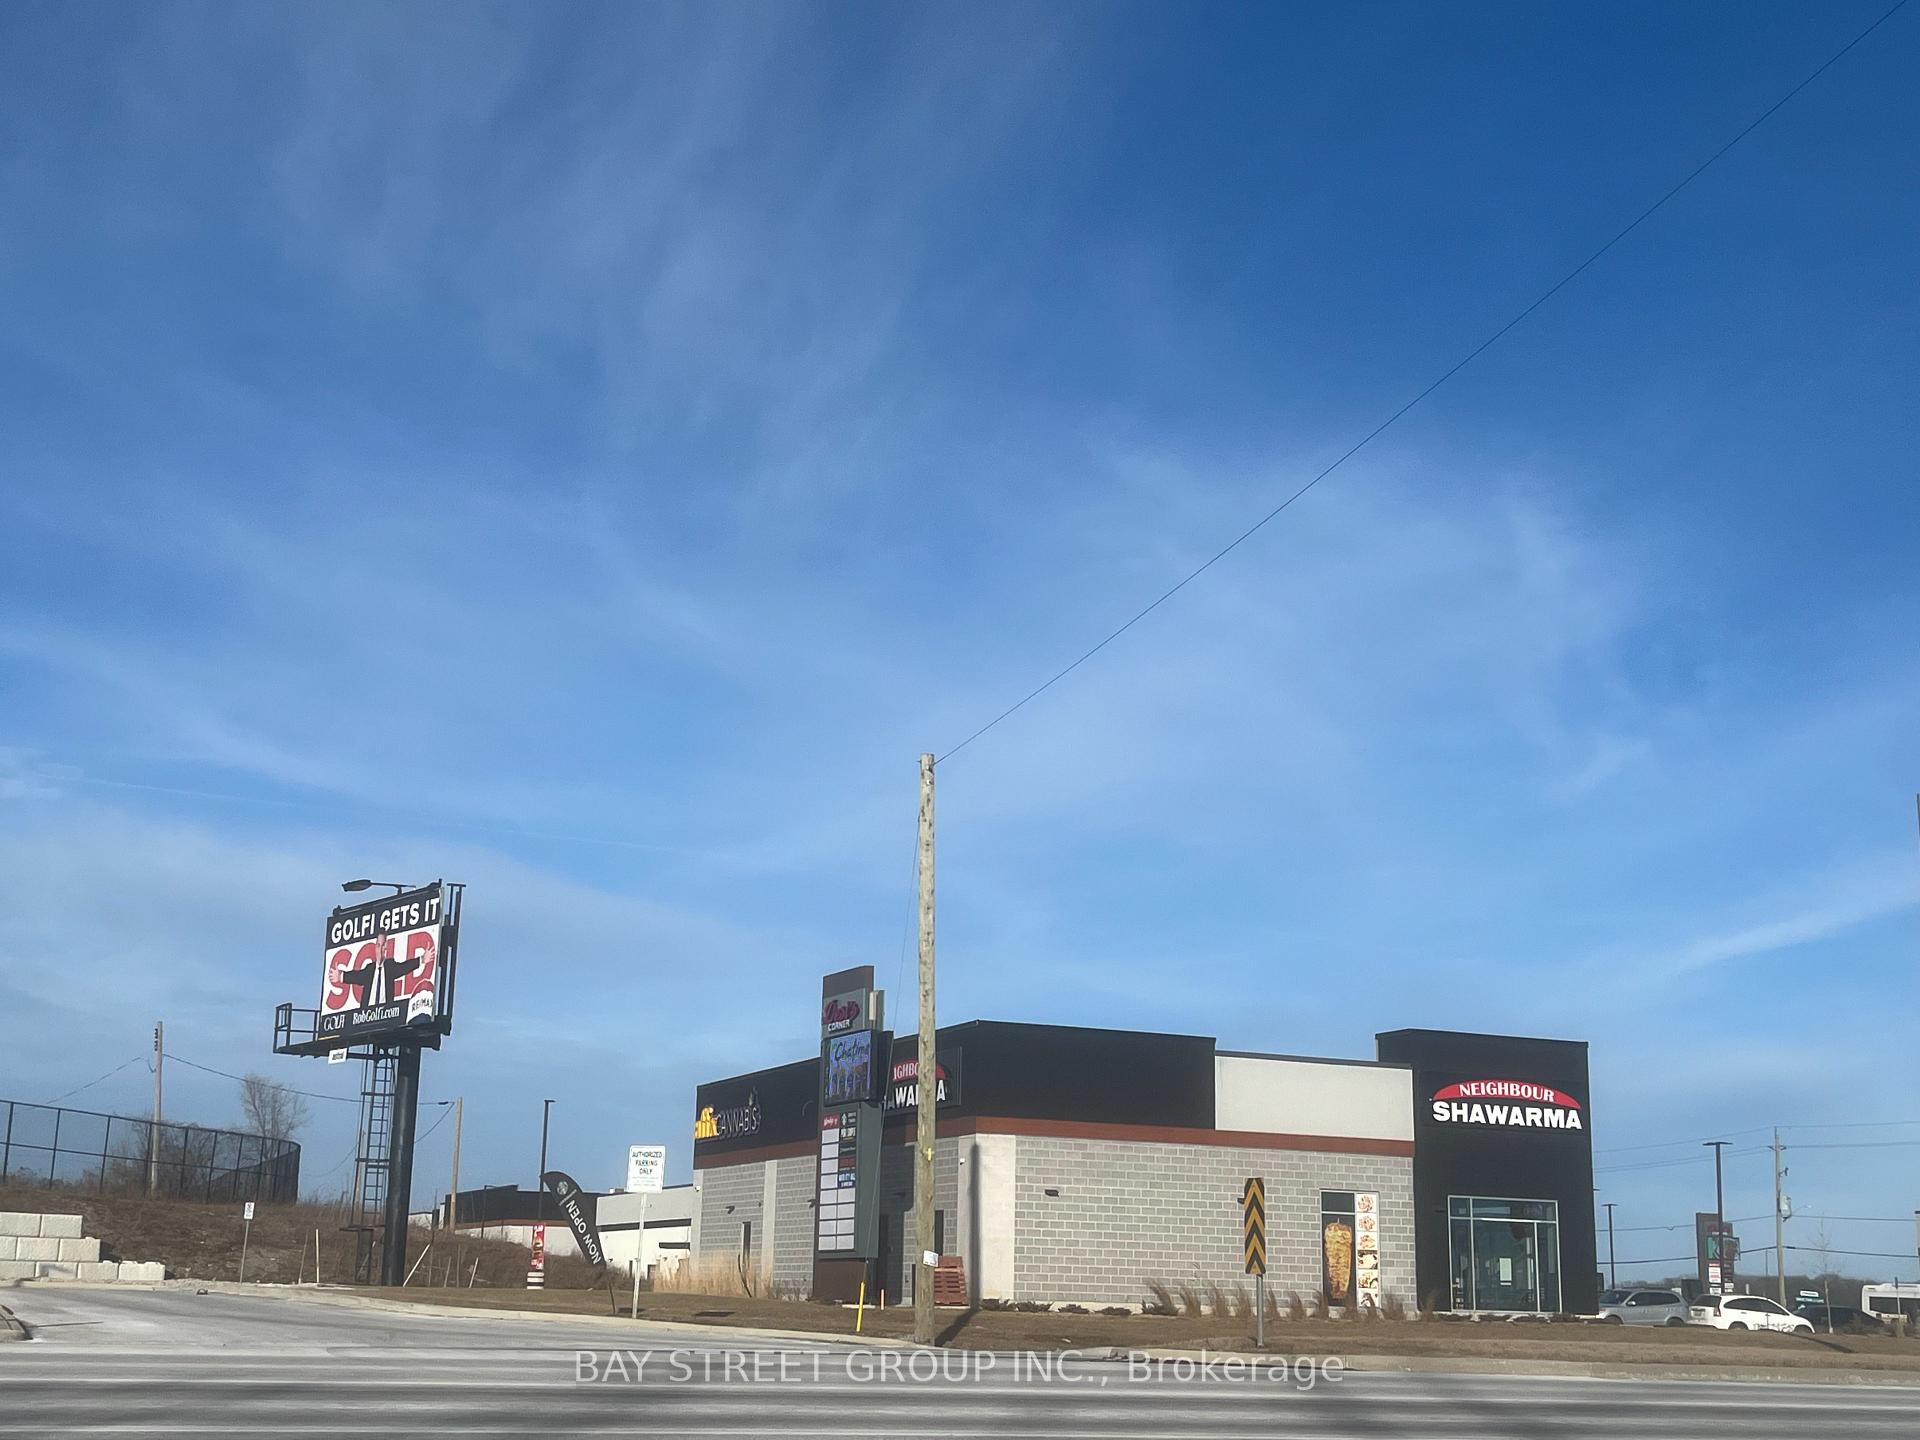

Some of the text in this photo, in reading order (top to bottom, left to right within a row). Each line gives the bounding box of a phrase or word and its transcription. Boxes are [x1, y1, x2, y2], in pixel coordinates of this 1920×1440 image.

[331, 898, 440, 943] GOLFI GETS IT
[827, 1019, 850, 1032] CORNER
[1459, 1081, 1555, 1103] NEIGHBOUR
[716, 1106, 758, 1136] CANNABIS
[1433, 1100, 1583, 1130] SHAWARMA
[635, 1159, 658, 1167] PARKING
[639, 1167, 653, 1175] ONLY
[565, 1200, 602, 1265] NOW OPEN
